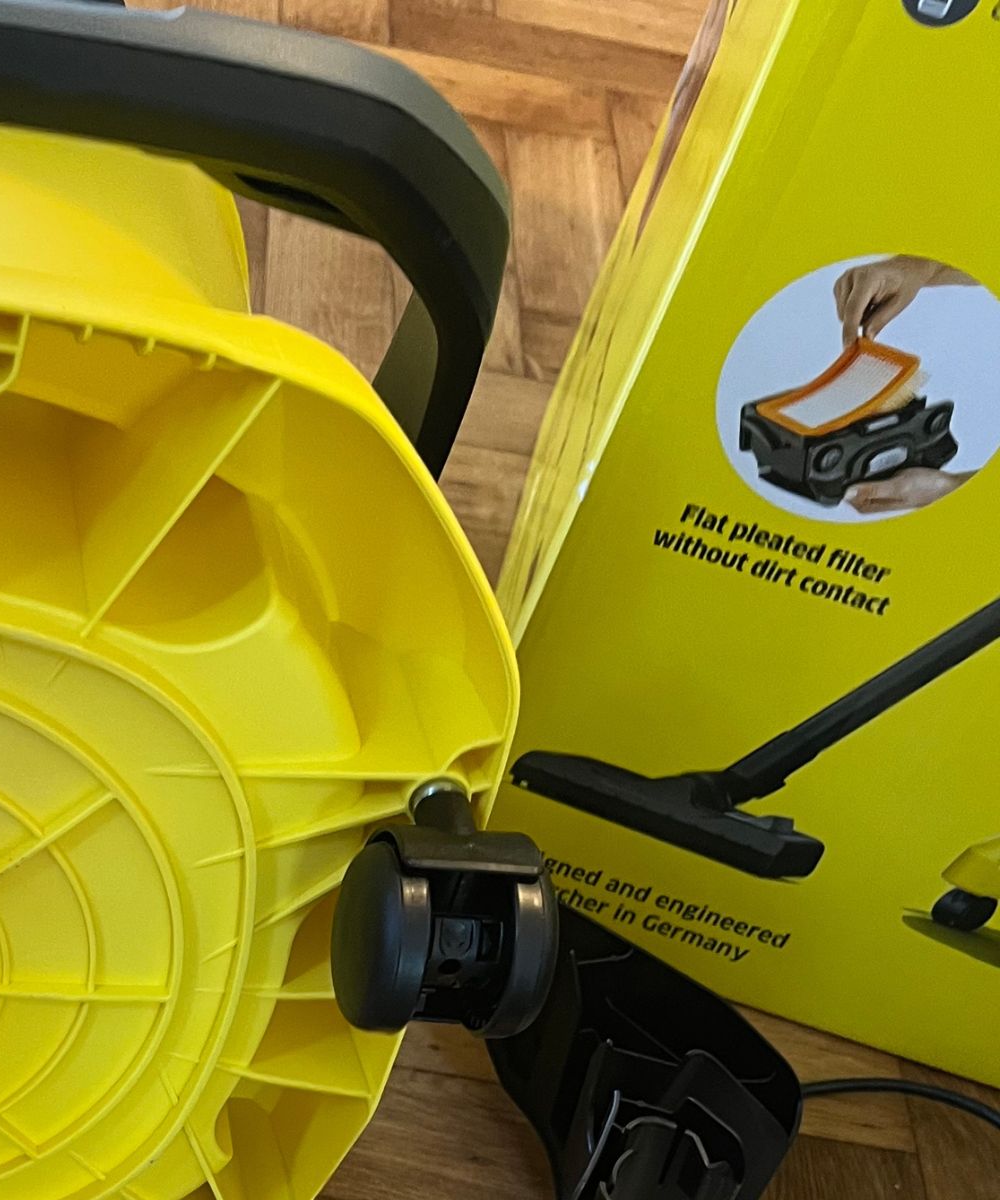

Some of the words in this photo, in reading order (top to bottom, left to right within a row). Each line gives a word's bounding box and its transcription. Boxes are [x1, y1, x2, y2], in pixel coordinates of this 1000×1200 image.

[653, 528, 750, 573] without
[750, 558, 798, 587] dirt
[799, 575, 890, 616] contact
[679, 503, 729, 534] Flat
[728, 521, 827, 564] pleated
[826, 548, 891, 583] filter
[553, 886, 610, 915] cher
[613, 903, 637, 925] in
[641, 914, 750, 963] Germany
[605, 877, 652, 903] and
[655, 894, 792, 950] engineered
